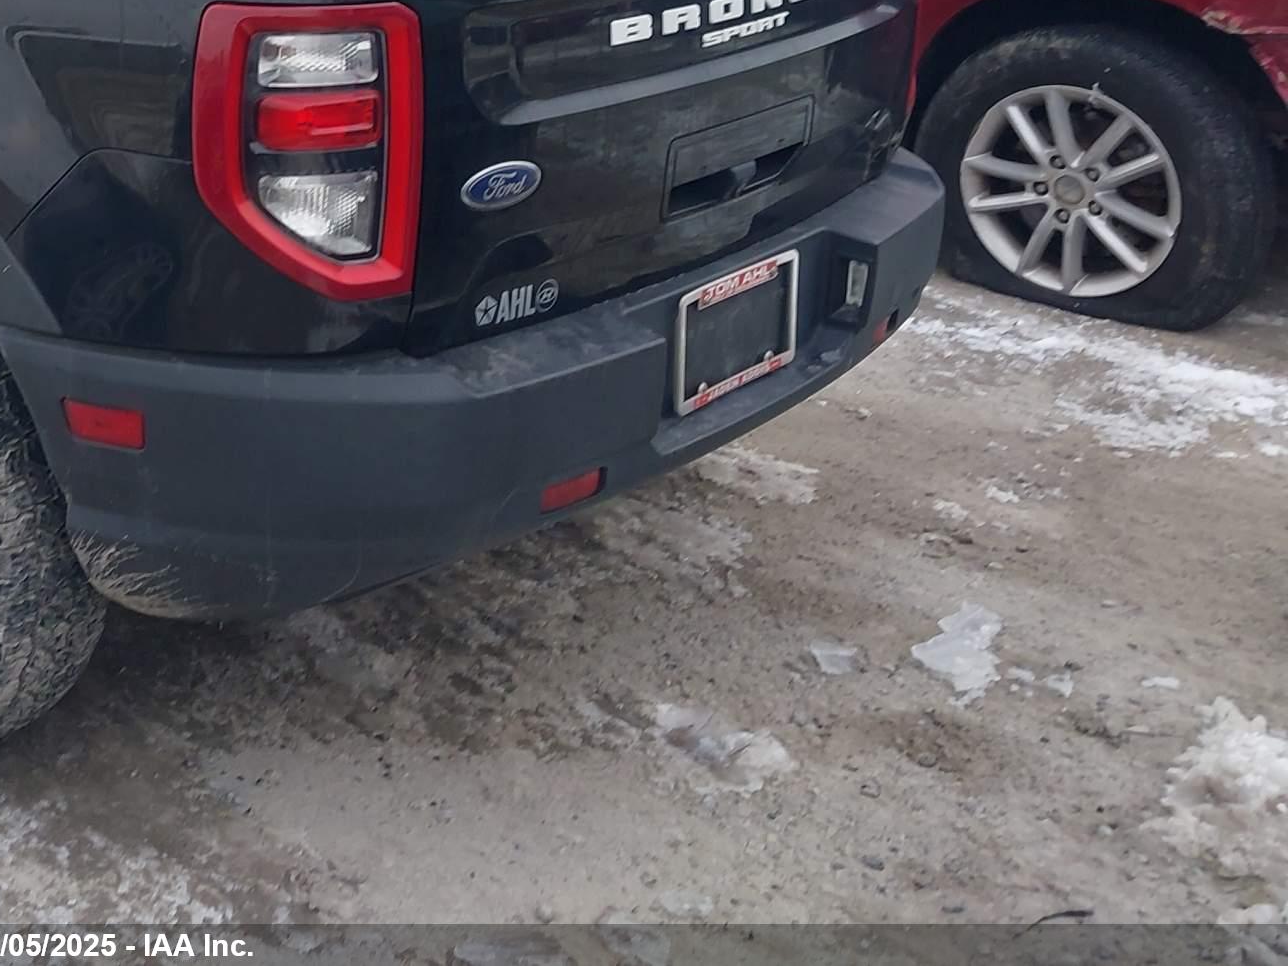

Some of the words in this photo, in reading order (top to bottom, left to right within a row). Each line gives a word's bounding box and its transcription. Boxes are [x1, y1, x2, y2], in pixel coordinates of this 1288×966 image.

[701, 11, 791, 48] SPORT
[742, 264, 775, 286] AHL
[494, 284, 536, 324] AHL
